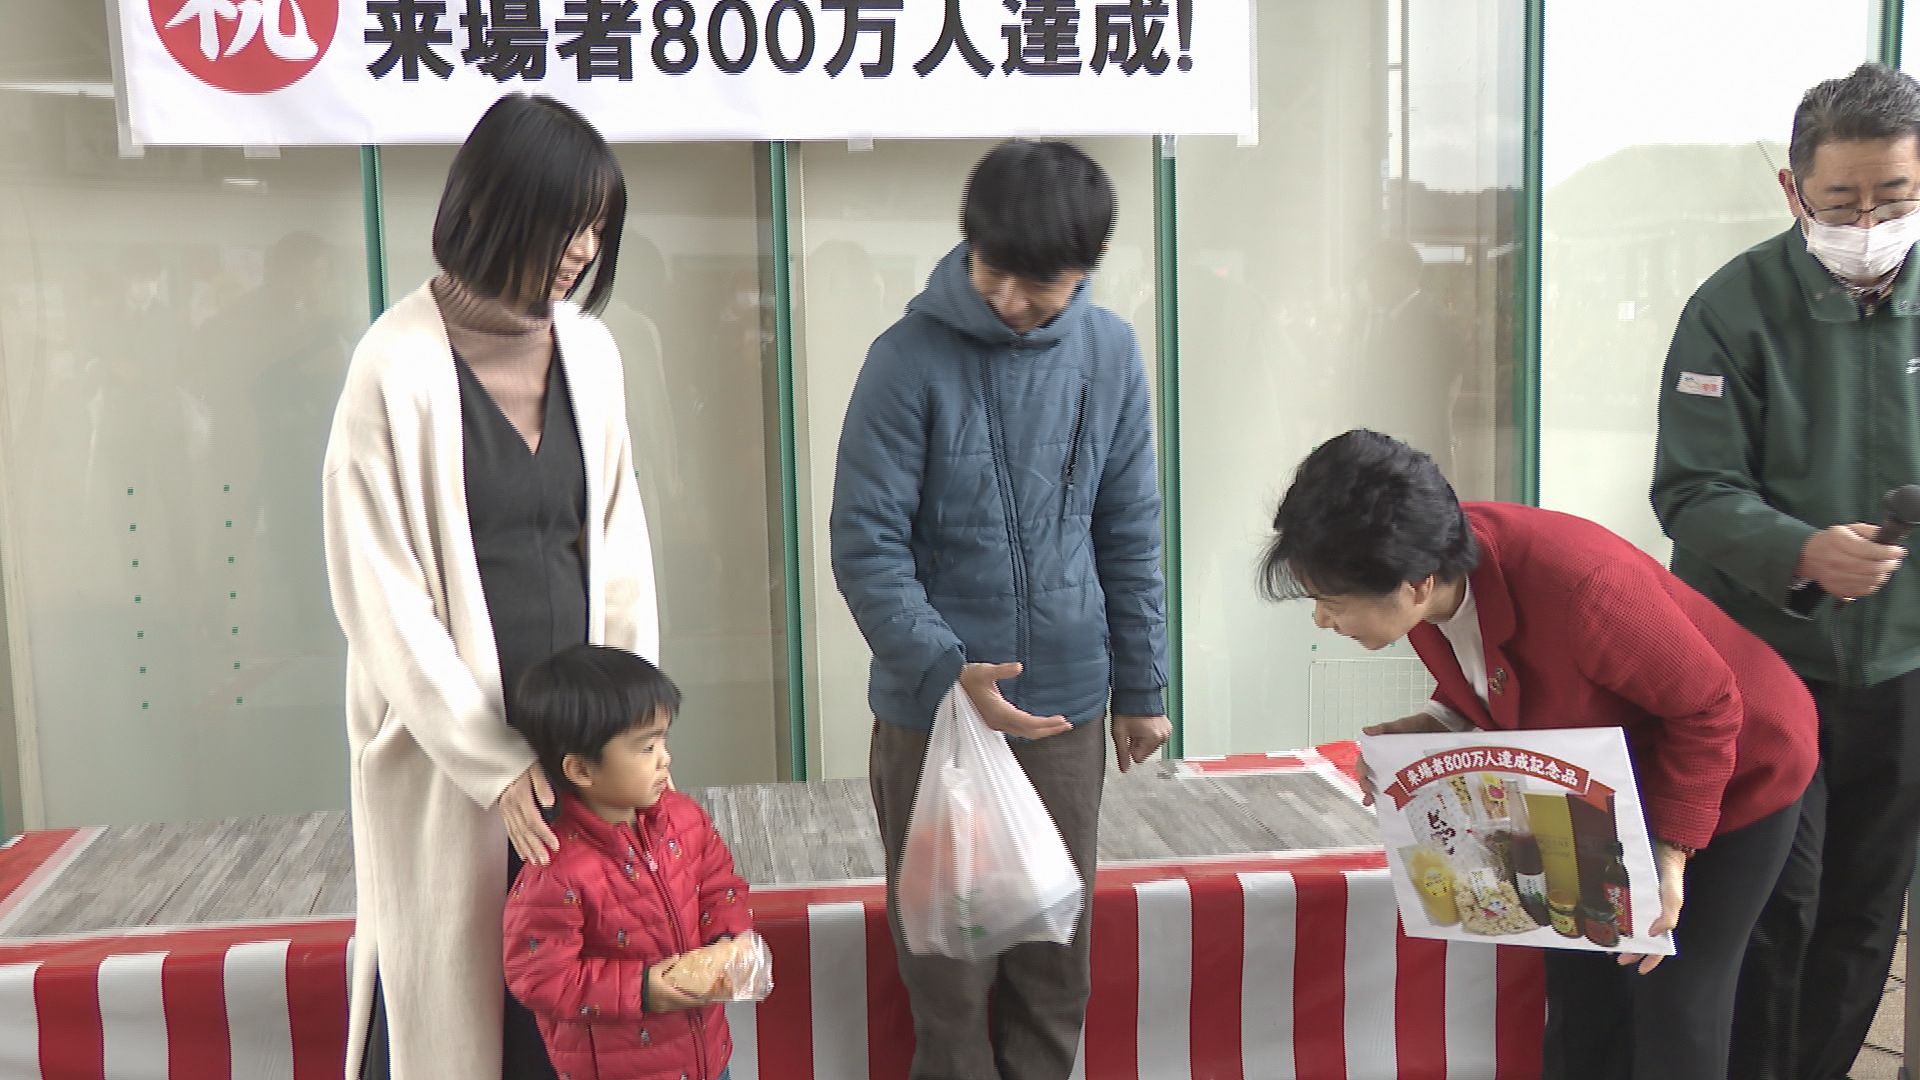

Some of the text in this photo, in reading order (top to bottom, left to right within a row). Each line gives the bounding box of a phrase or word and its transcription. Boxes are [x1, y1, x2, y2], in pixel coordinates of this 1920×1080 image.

[364, 0, 1193, 82] 来場者800万人達成!
[1406, 750, 1578, 786] 来場者800万人達成記念品
